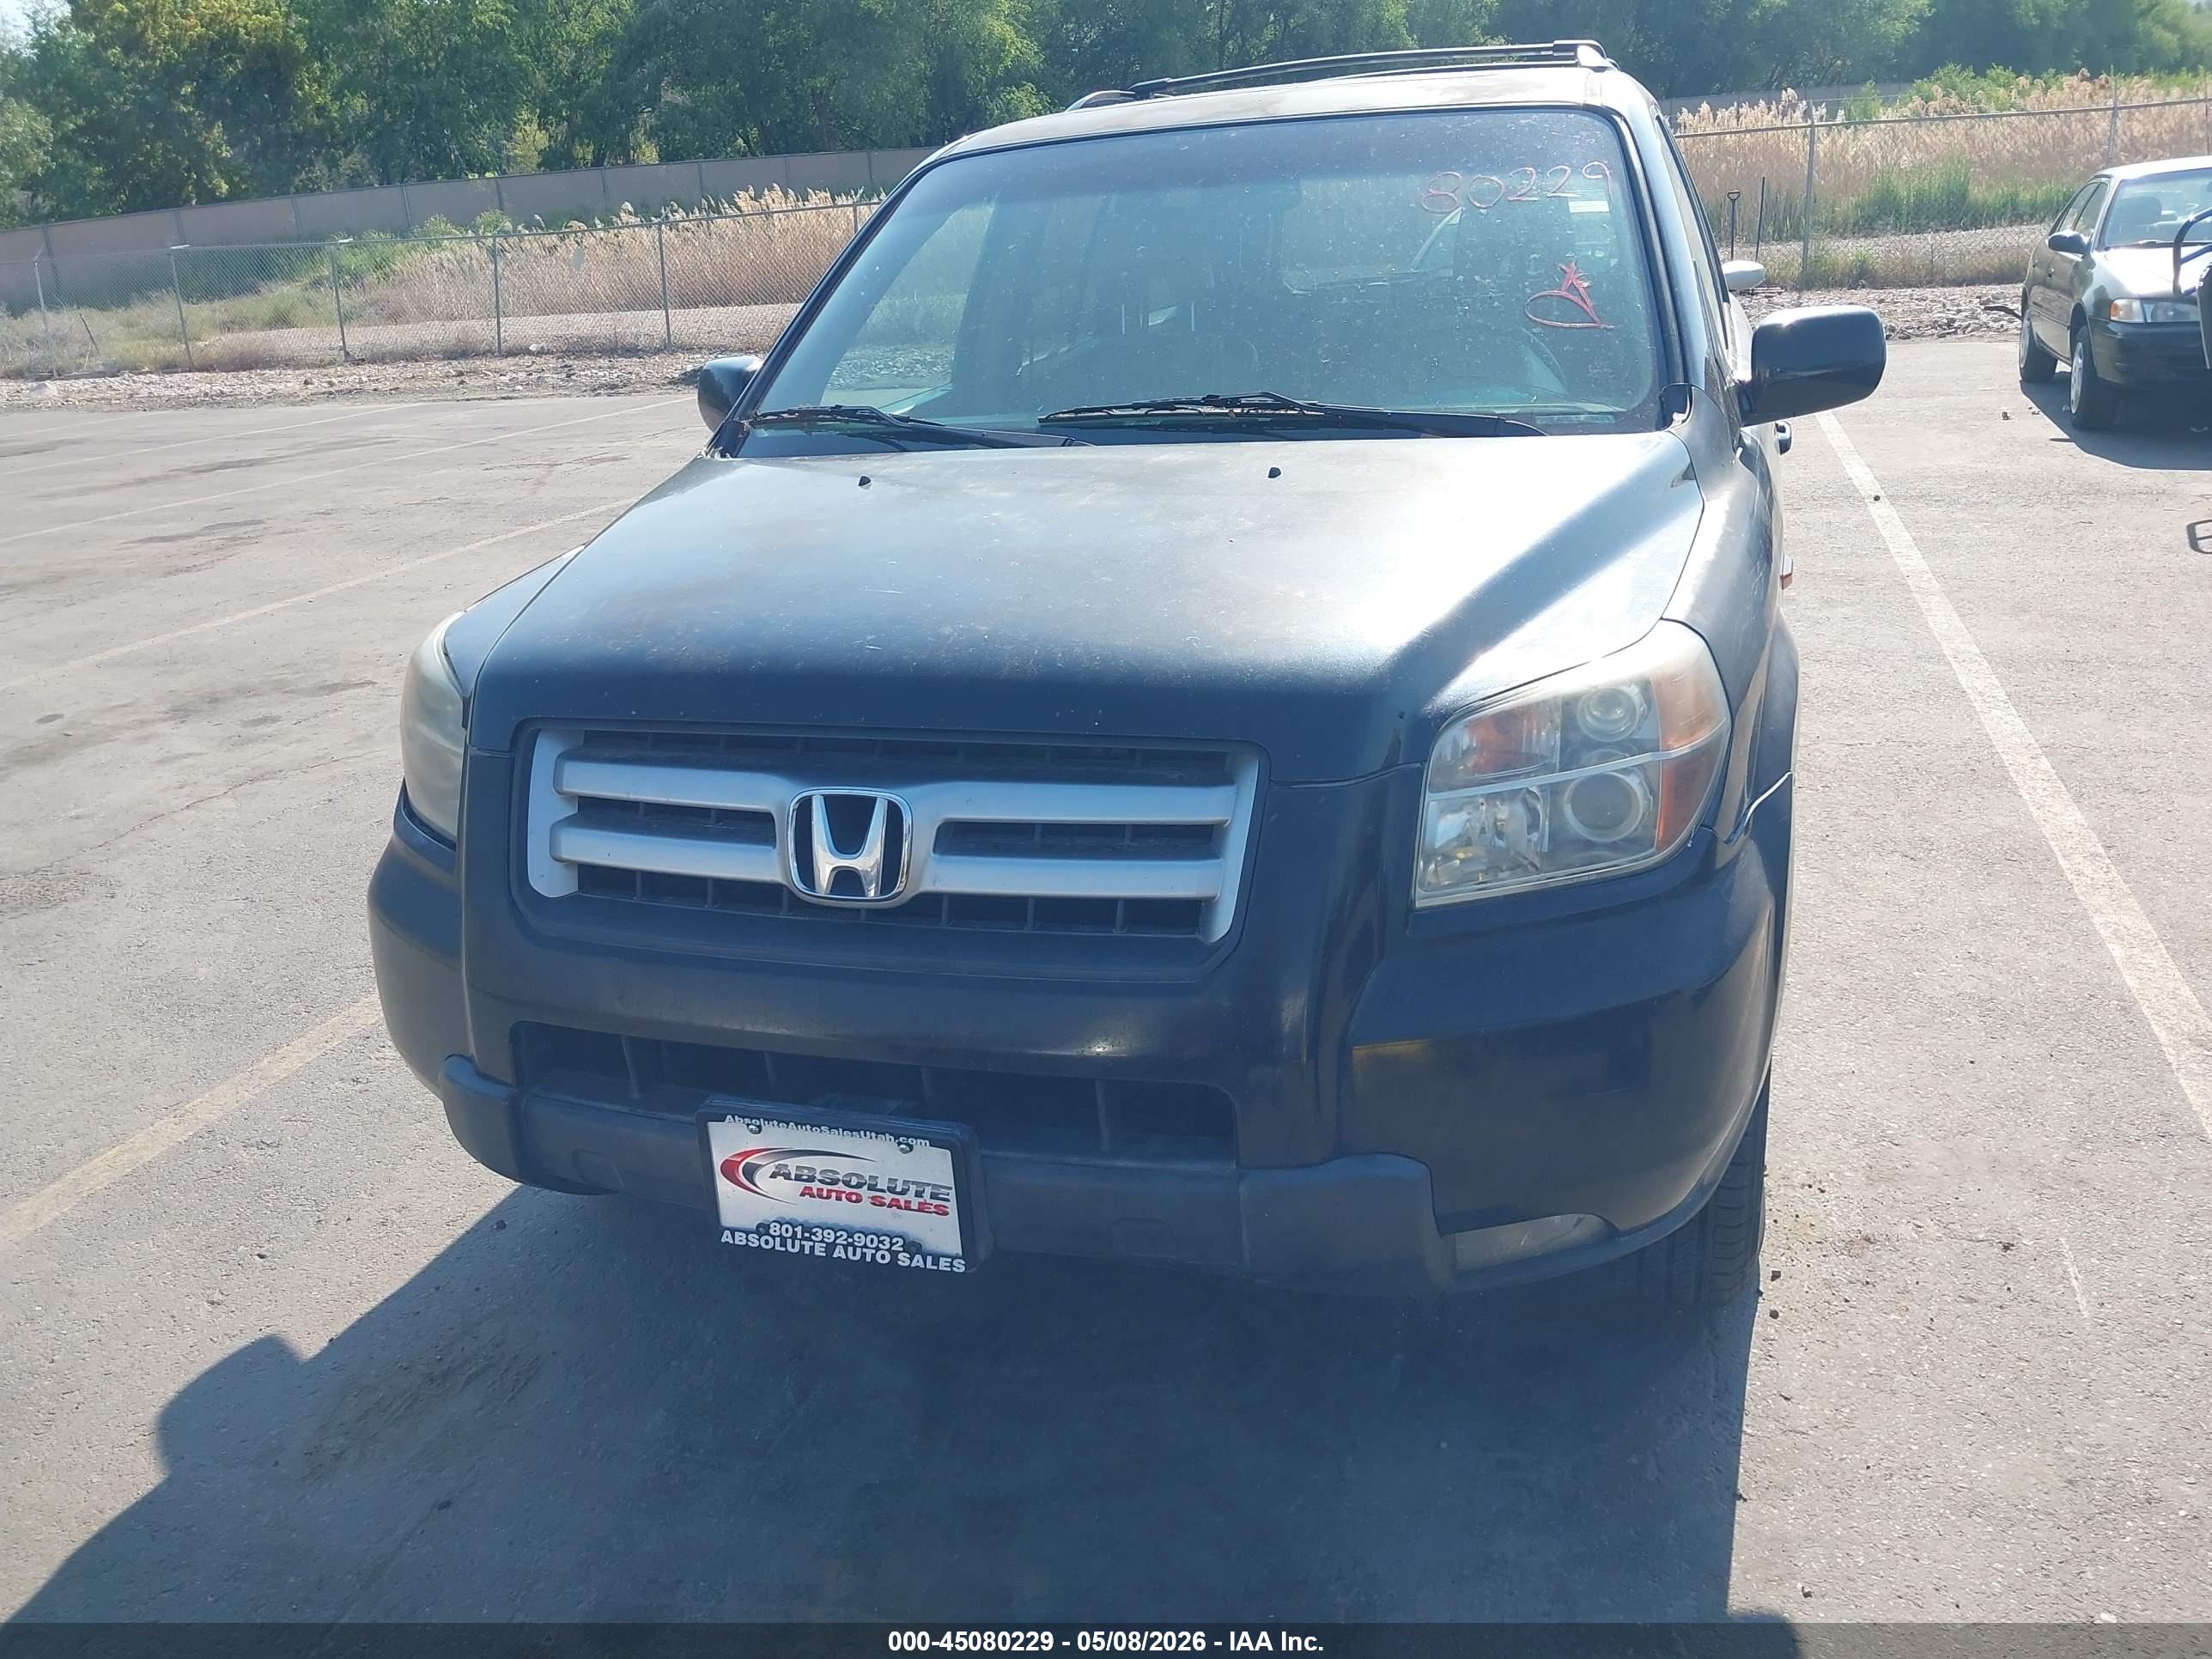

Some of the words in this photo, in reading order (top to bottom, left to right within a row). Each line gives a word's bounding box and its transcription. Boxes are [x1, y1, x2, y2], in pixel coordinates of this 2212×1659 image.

[1421, 161, 1613, 214] 80229
[724, 1115, 930, 1147] AbsoluteAutoSalesUtah.com
[769, 1163, 953, 1203] ABSOLUTE
[799, 1186, 864, 1205] AUTO
[867, 1194, 950, 1217] SALES
[720, 1229, 827, 1257] ABSOLUTE
[832, 1244, 891, 1265] AUTO
[896, 1251, 967, 1273] SALES
[768, 1221, 904, 1251] 801-392-9032
